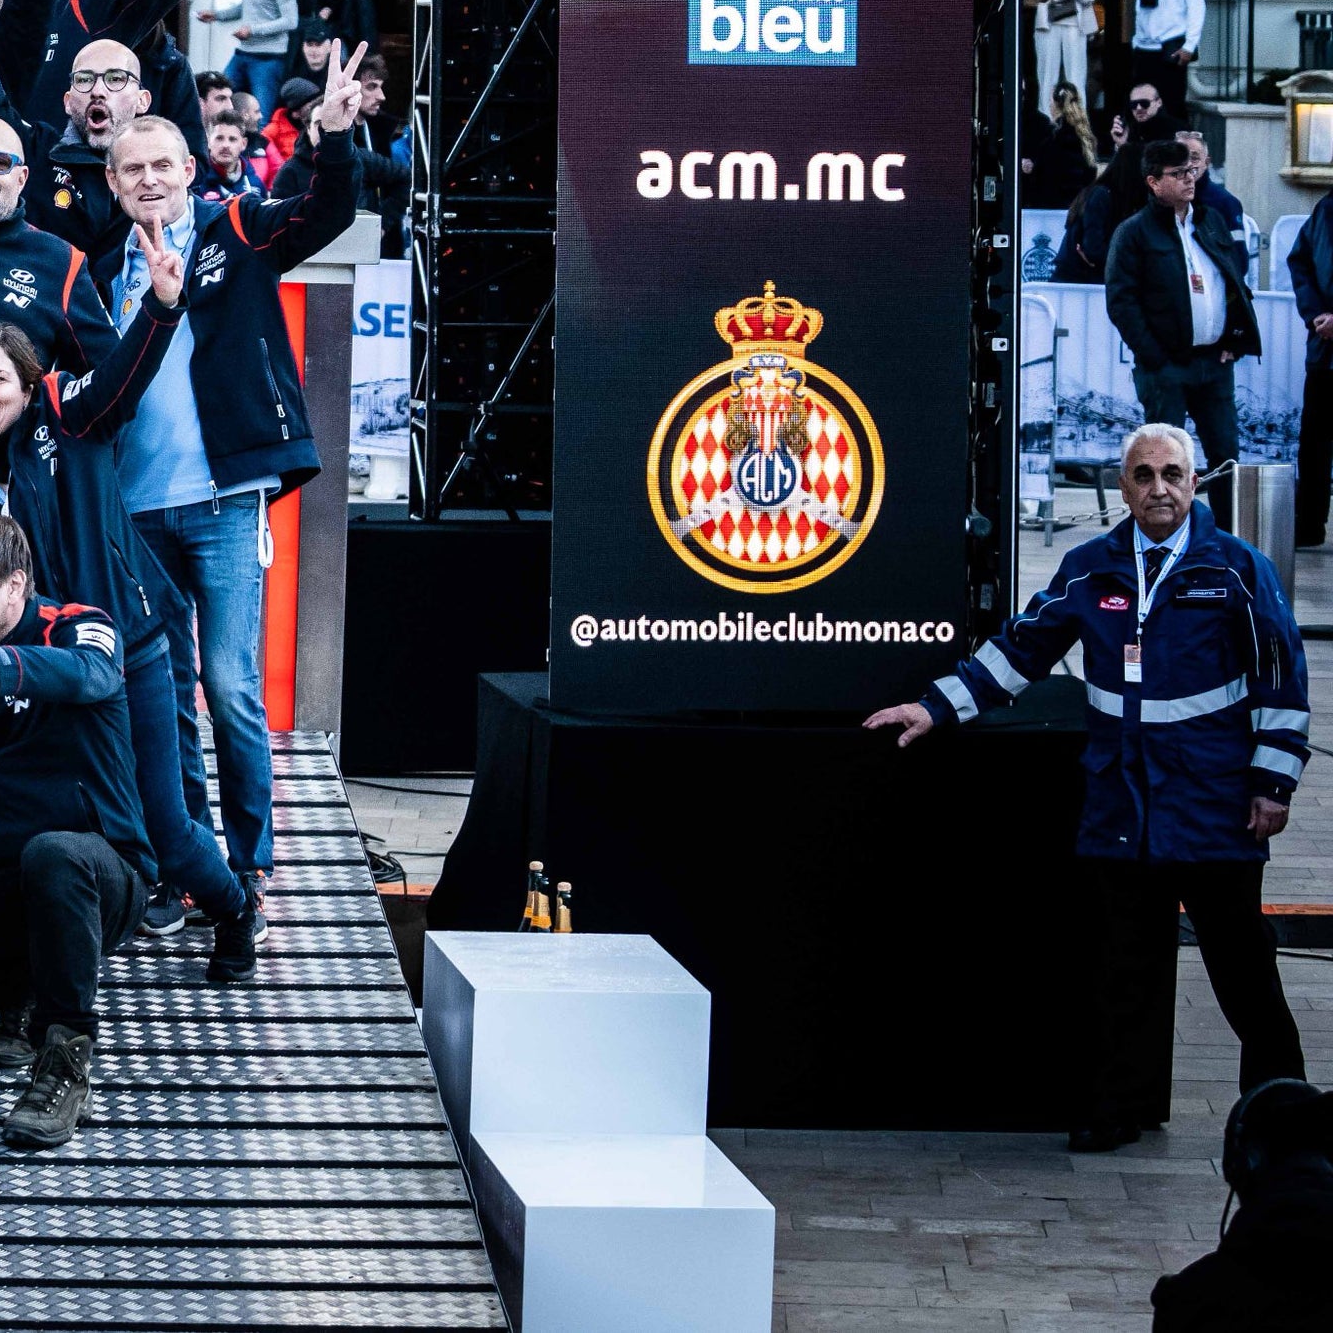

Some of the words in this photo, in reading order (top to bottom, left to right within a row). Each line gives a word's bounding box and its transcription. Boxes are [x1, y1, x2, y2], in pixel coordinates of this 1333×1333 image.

[635, 148, 907, 202] acm.mc
[351, 301, 412, 338] SE
[571, 611, 955, 647] @automobileclubmonaco
